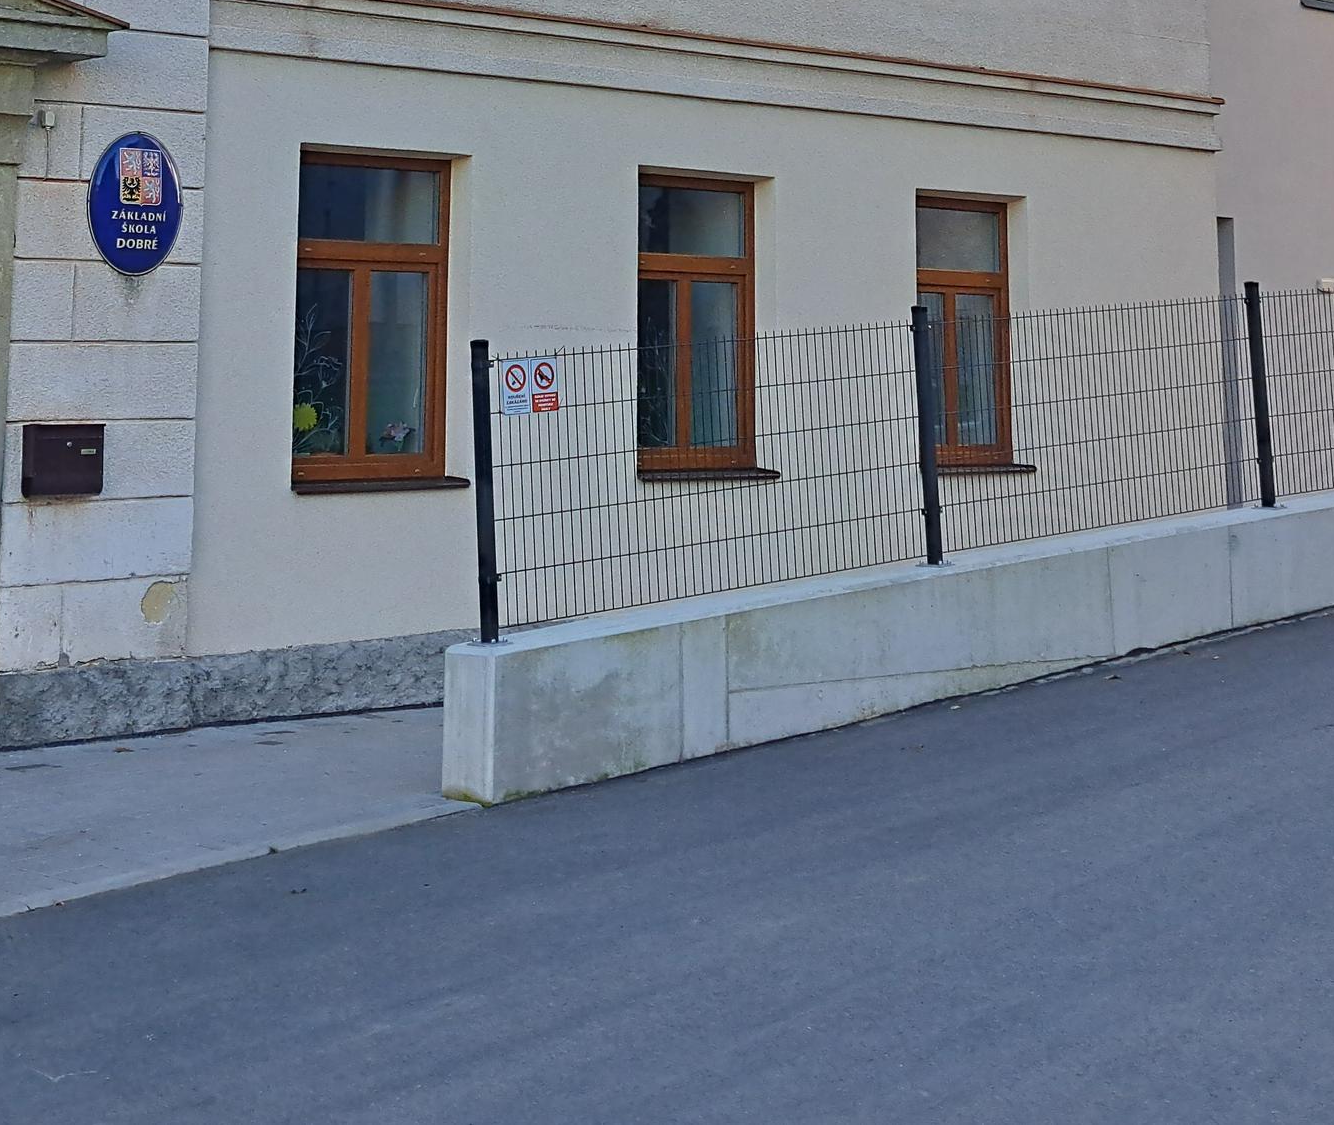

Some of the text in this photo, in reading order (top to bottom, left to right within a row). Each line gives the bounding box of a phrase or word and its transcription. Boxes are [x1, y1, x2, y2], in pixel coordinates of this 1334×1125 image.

[111, 208, 166, 222] ZÁKLADNÍ
[121, 222, 156, 234] ŠKOLA
[116, 237, 158, 250] DOBRÉ
